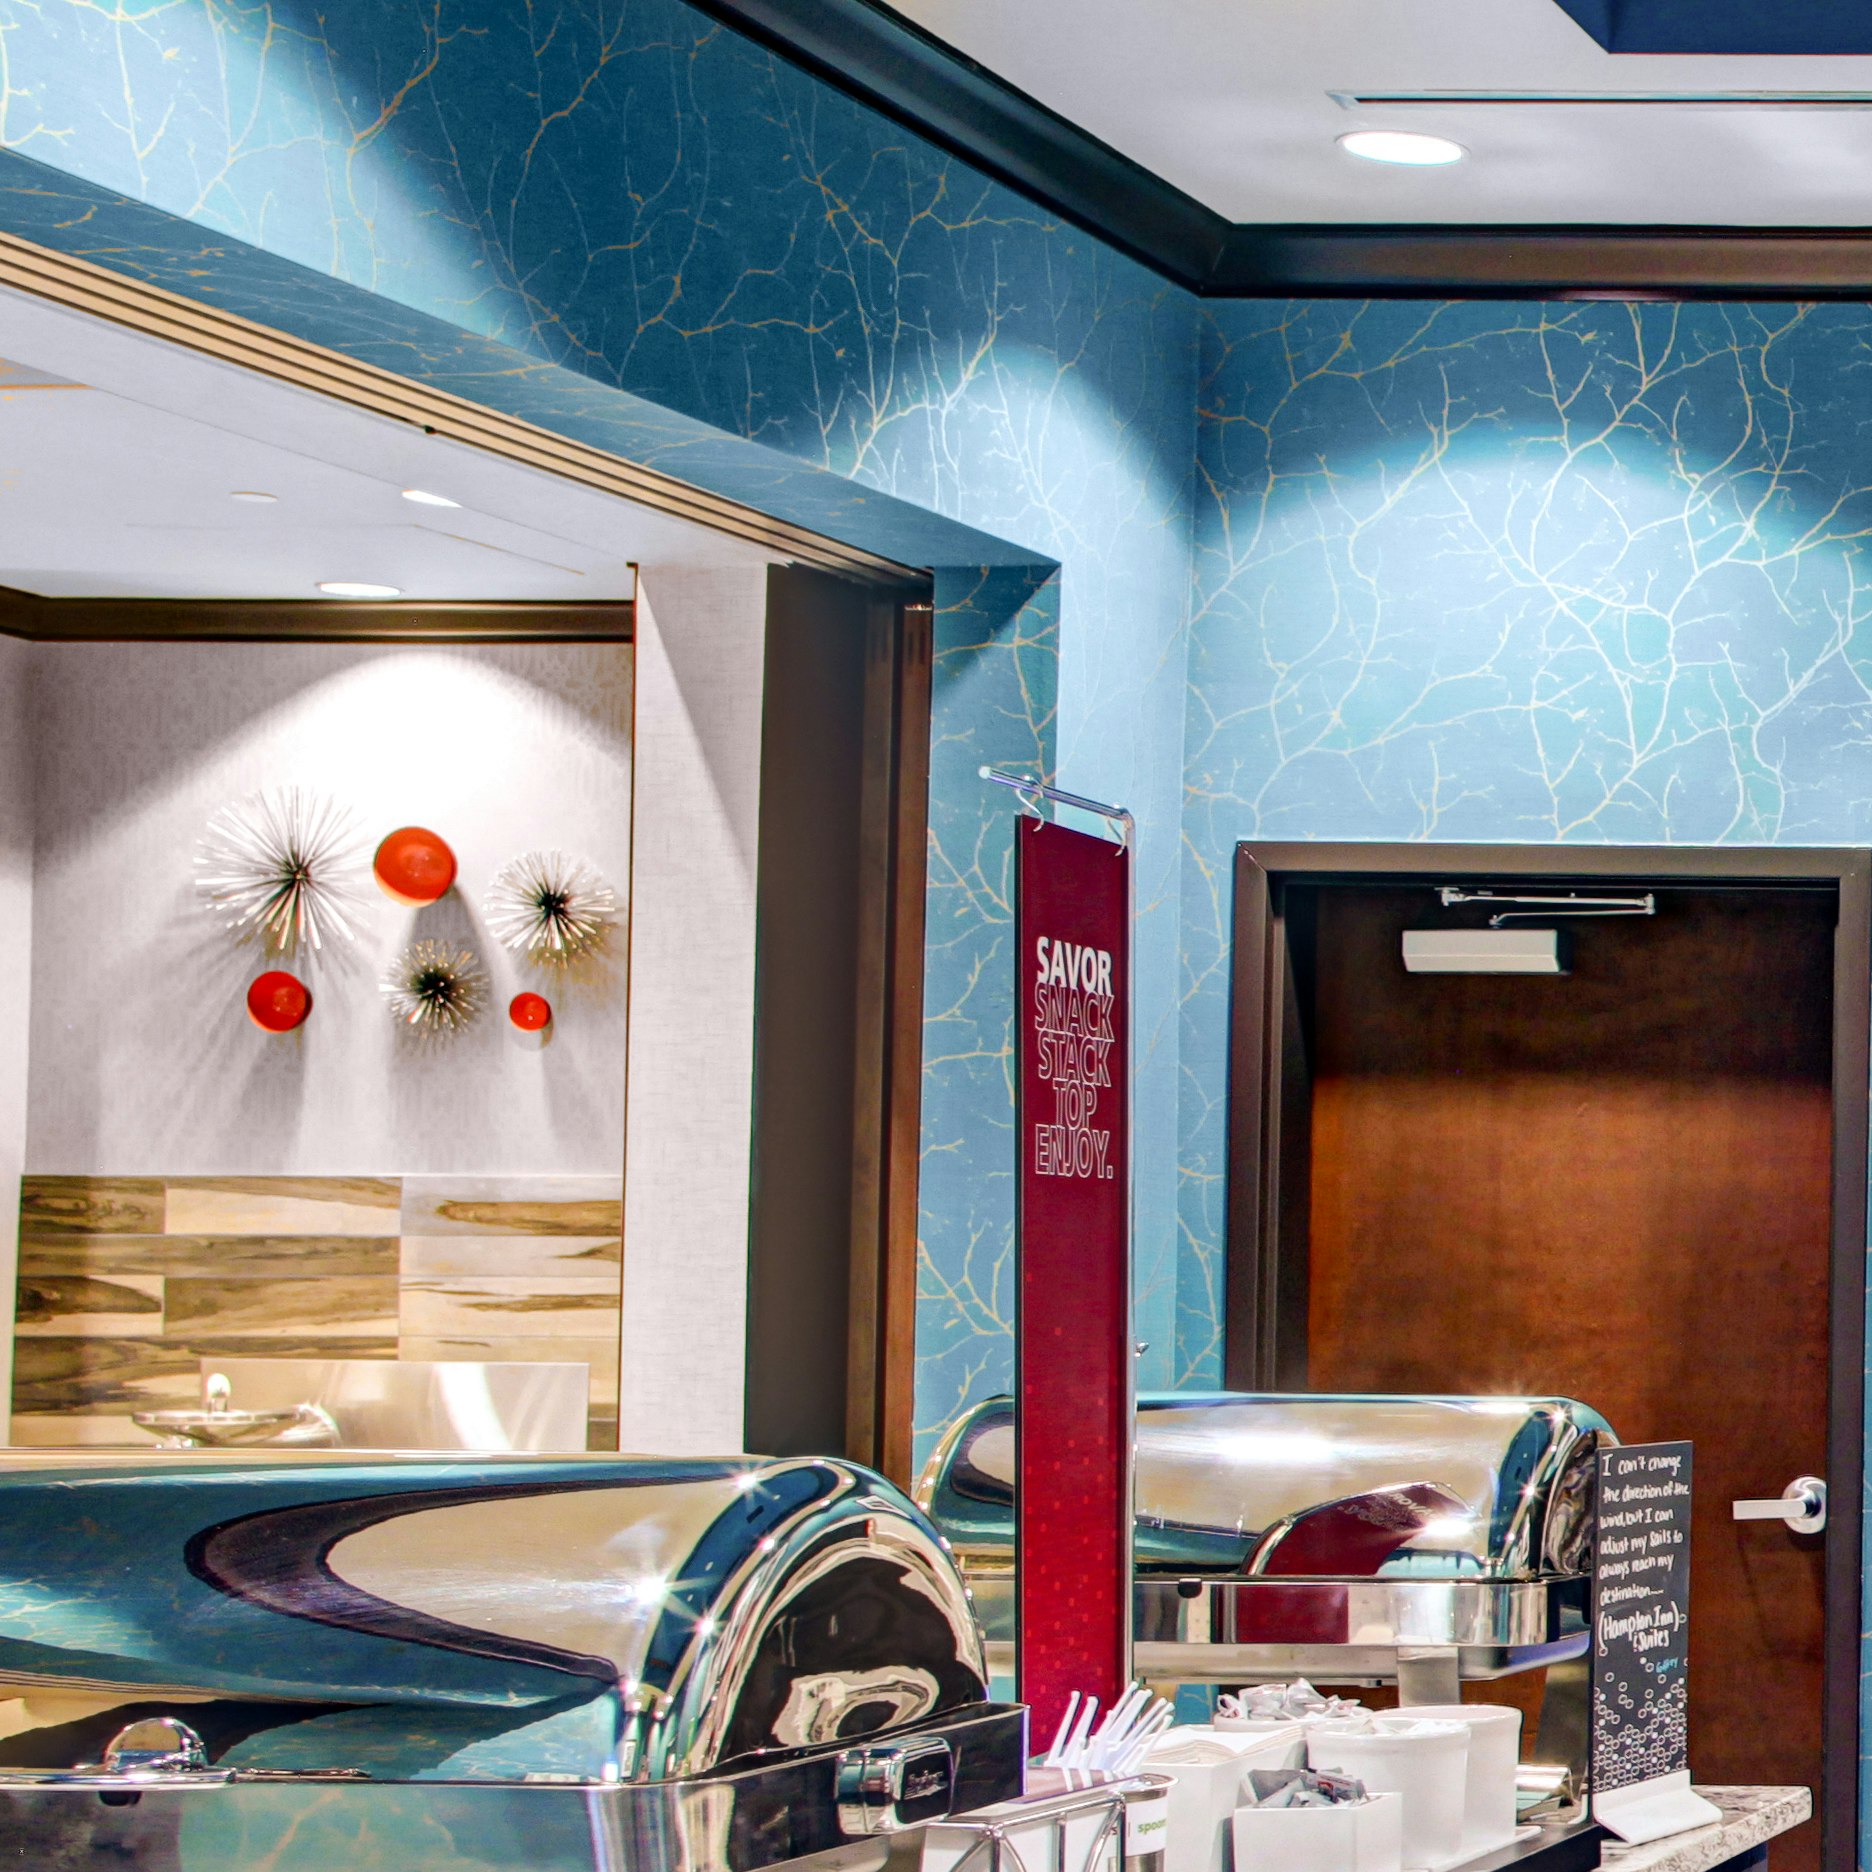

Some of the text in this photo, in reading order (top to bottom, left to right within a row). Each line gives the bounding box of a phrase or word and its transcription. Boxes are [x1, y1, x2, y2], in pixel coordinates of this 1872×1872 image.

[1036, 936, 1112, 996] SAVOR
[1035, 982, 1115, 1043] SNACK
[1037, 1028, 1112, 1088] STACK
[1052, 1080, 1097, 1130] TOP
[1034, 1124, 1114, 1180] ENJOY.
[1602, 1453, 1613, 1476] I
[1648, 1455, 1681, 1476] change
[1603, 1481, 1690, 1503] the direction of the
[1654, 1509, 1674, 1522] can
[1599, 1535, 1629, 1555] adjust
[1630, 1535, 1647, 1555] my
[1673, 1530, 1683, 1543] to
[1599, 1554, 1674, 1580] always reach my
